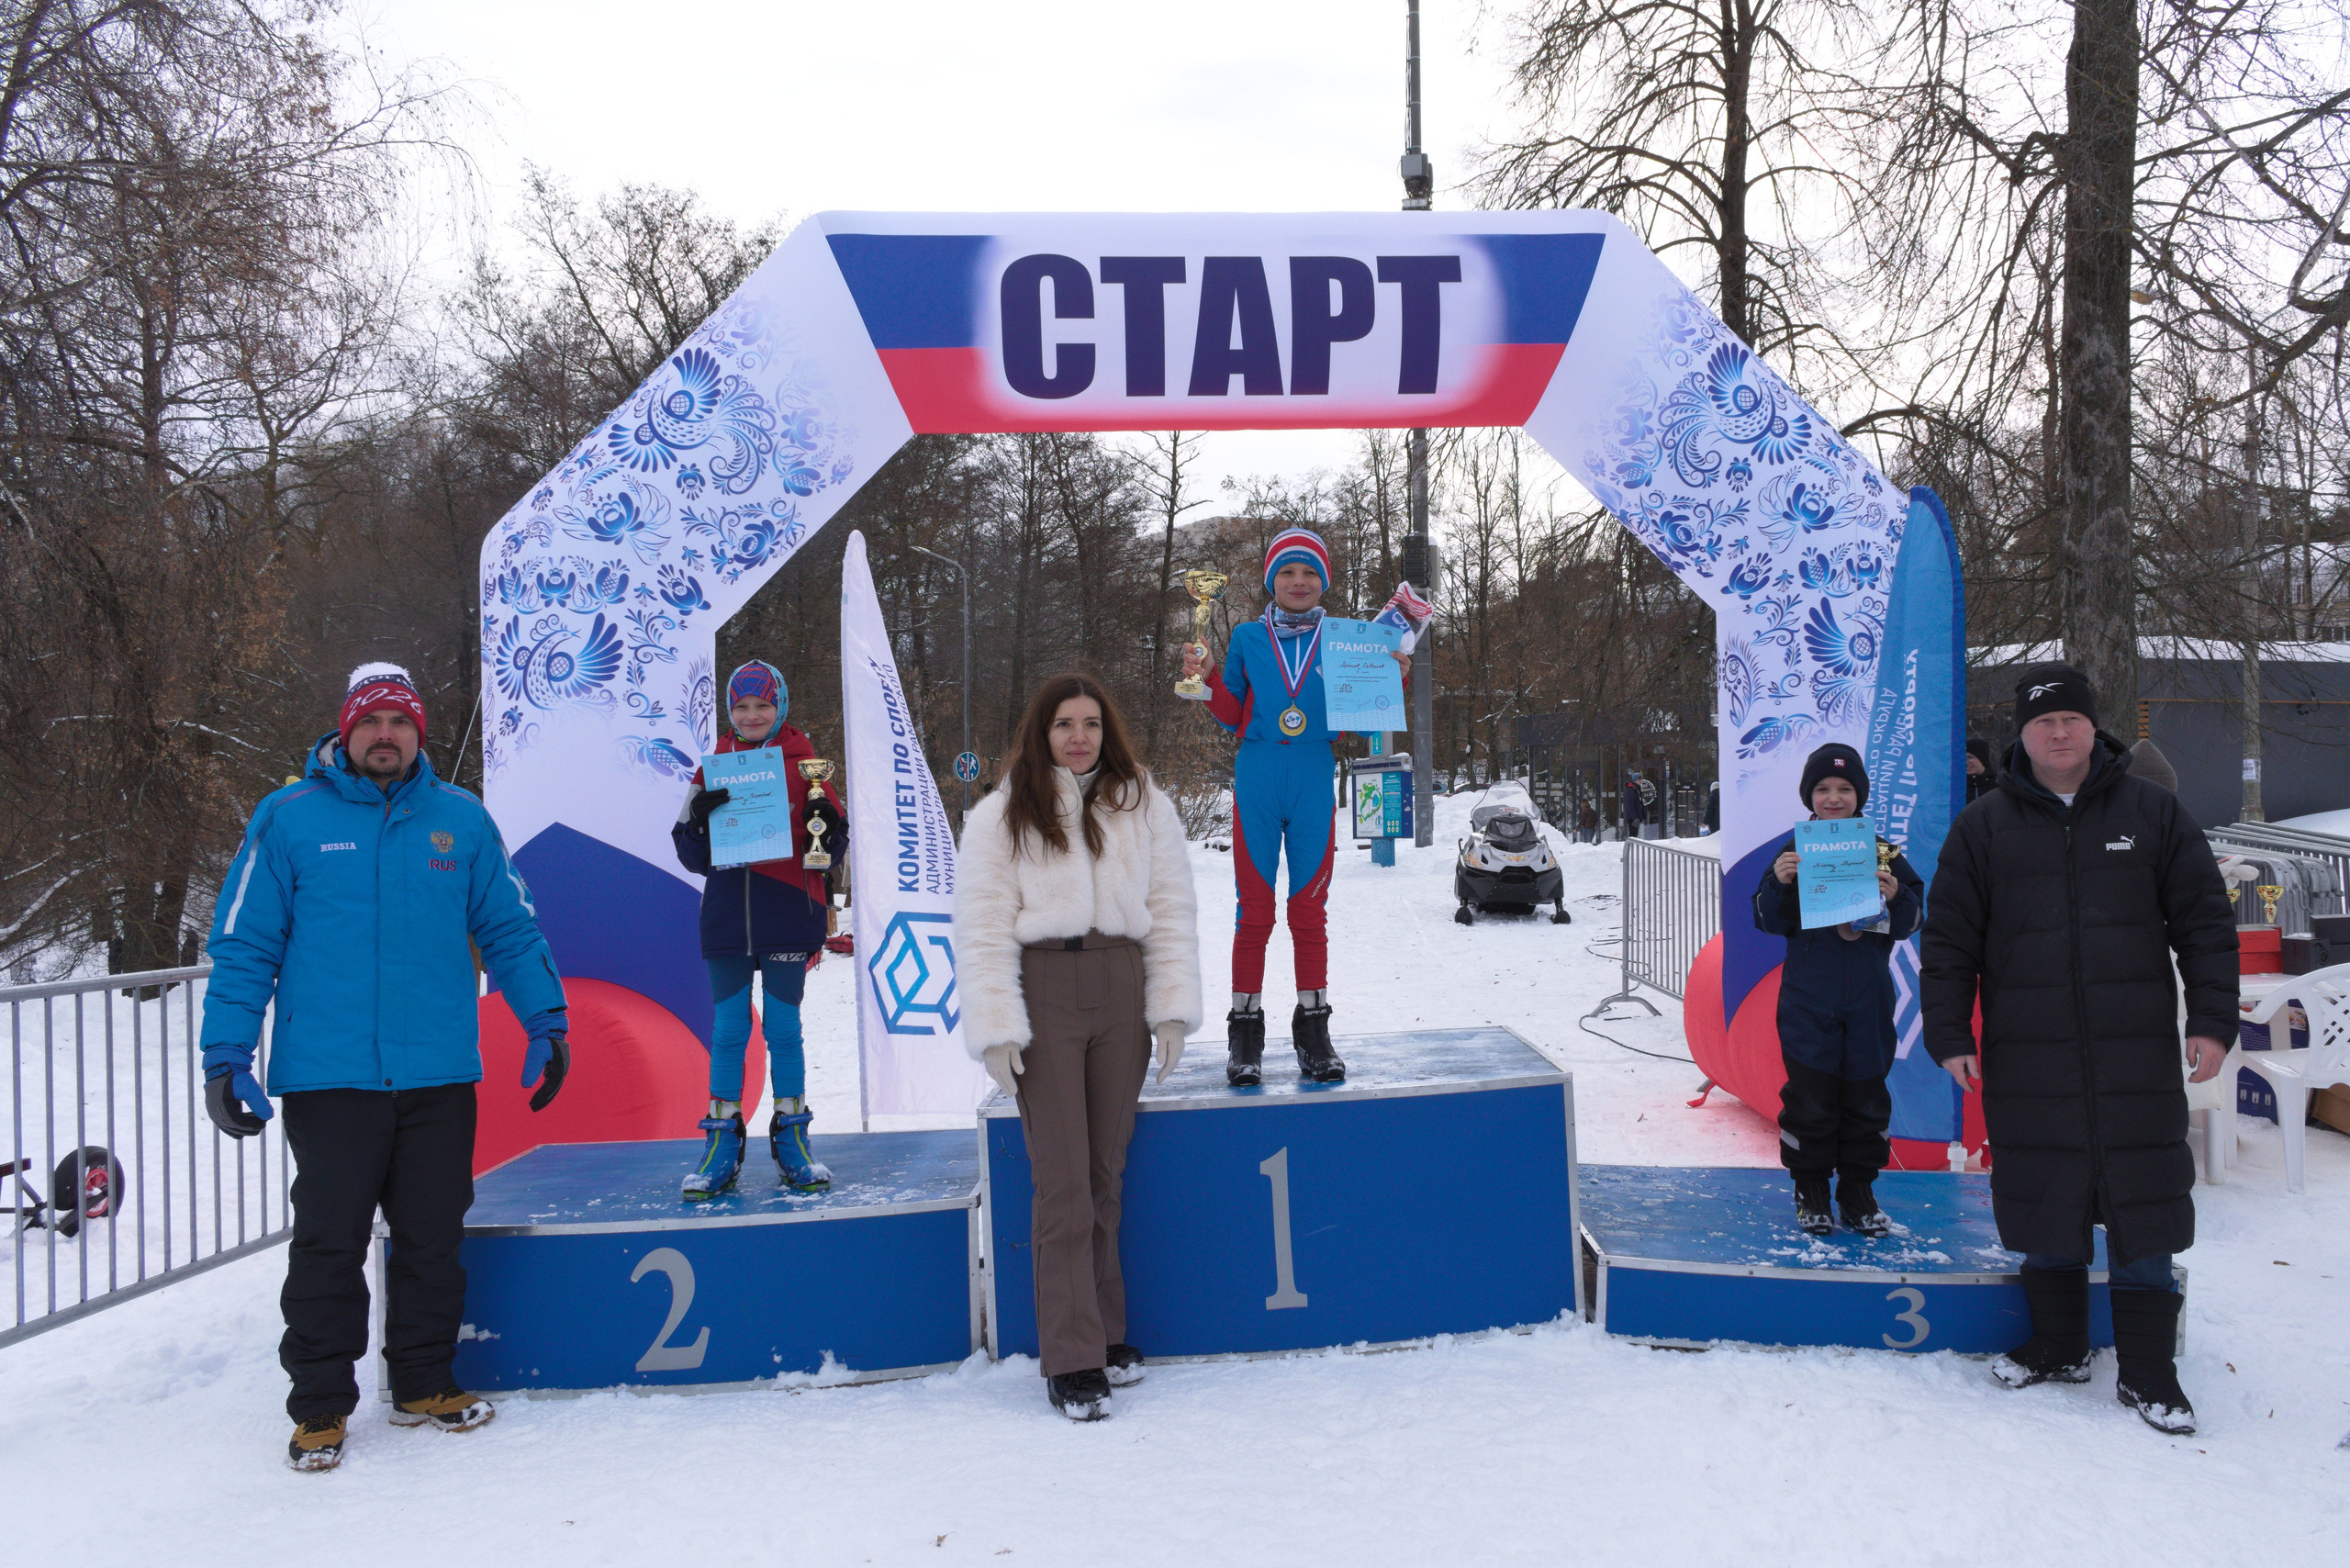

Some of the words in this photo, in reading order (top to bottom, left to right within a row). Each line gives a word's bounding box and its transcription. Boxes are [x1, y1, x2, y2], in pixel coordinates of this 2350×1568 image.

[1000, 252, 1462, 400] СТАРТ
[1281, 554, 1310, 562] NORDSKI
[1329, 642, 1389, 654] ГРАМОТА
[867, 655, 906, 737] СПОРТУ
[892, 743, 912, 775] ПО
[712, 771, 777, 787] ГРАМОТА
[895, 780, 920, 892] КОМИТЕТ
[914, 757, 941, 895] АДМИНИСТРАЦИИ
[319, 842, 357, 852] RUSSIA
[1805, 841, 1867, 853] ГРАМОТА
[2106, 843, 2132, 851] PUMA
[430, 859, 457, 871] RUS
[1311, 870, 1329, 898] NORDSKI
[1304, 1008, 1327, 1016] SPINE
[1259, 1146, 1309, 1311] 1
[629, 1247, 711, 1372] 2
[1882, 1286, 1931, 1349] 3
